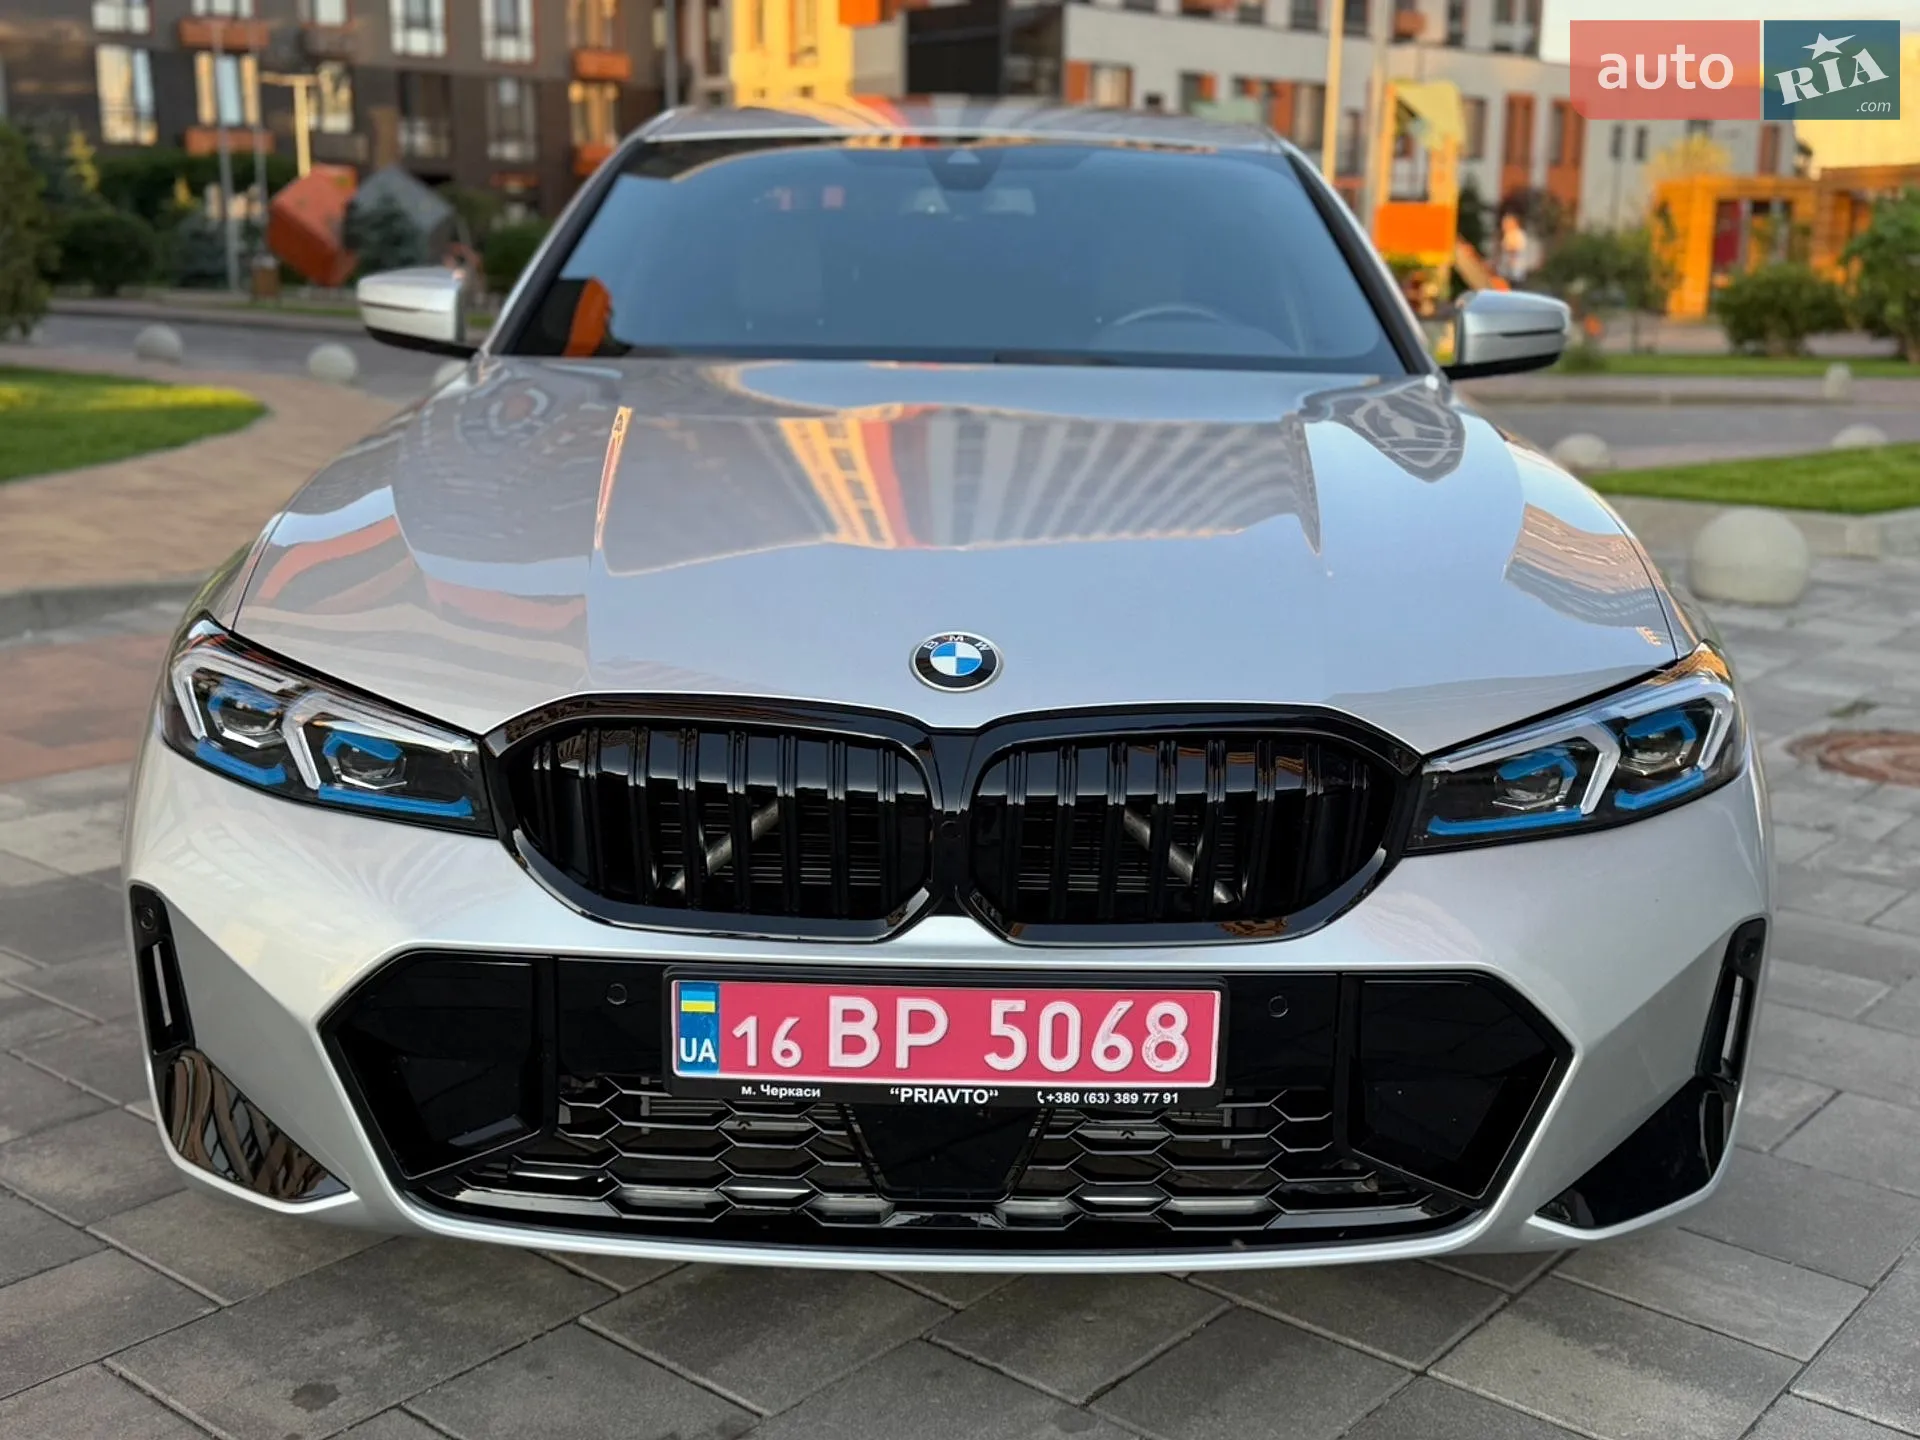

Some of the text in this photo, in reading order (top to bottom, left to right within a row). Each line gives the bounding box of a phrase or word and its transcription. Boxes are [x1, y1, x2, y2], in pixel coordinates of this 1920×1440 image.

[922, 634, 992, 650] BMW
[731, 995, 1190, 1073] 16 BP 5068
[679, 1037, 717, 1063] UA
[760, 1084, 821, 1098] Черкаси
[1046, 1091, 1179, 1105] +380 (63) 389 77 91
